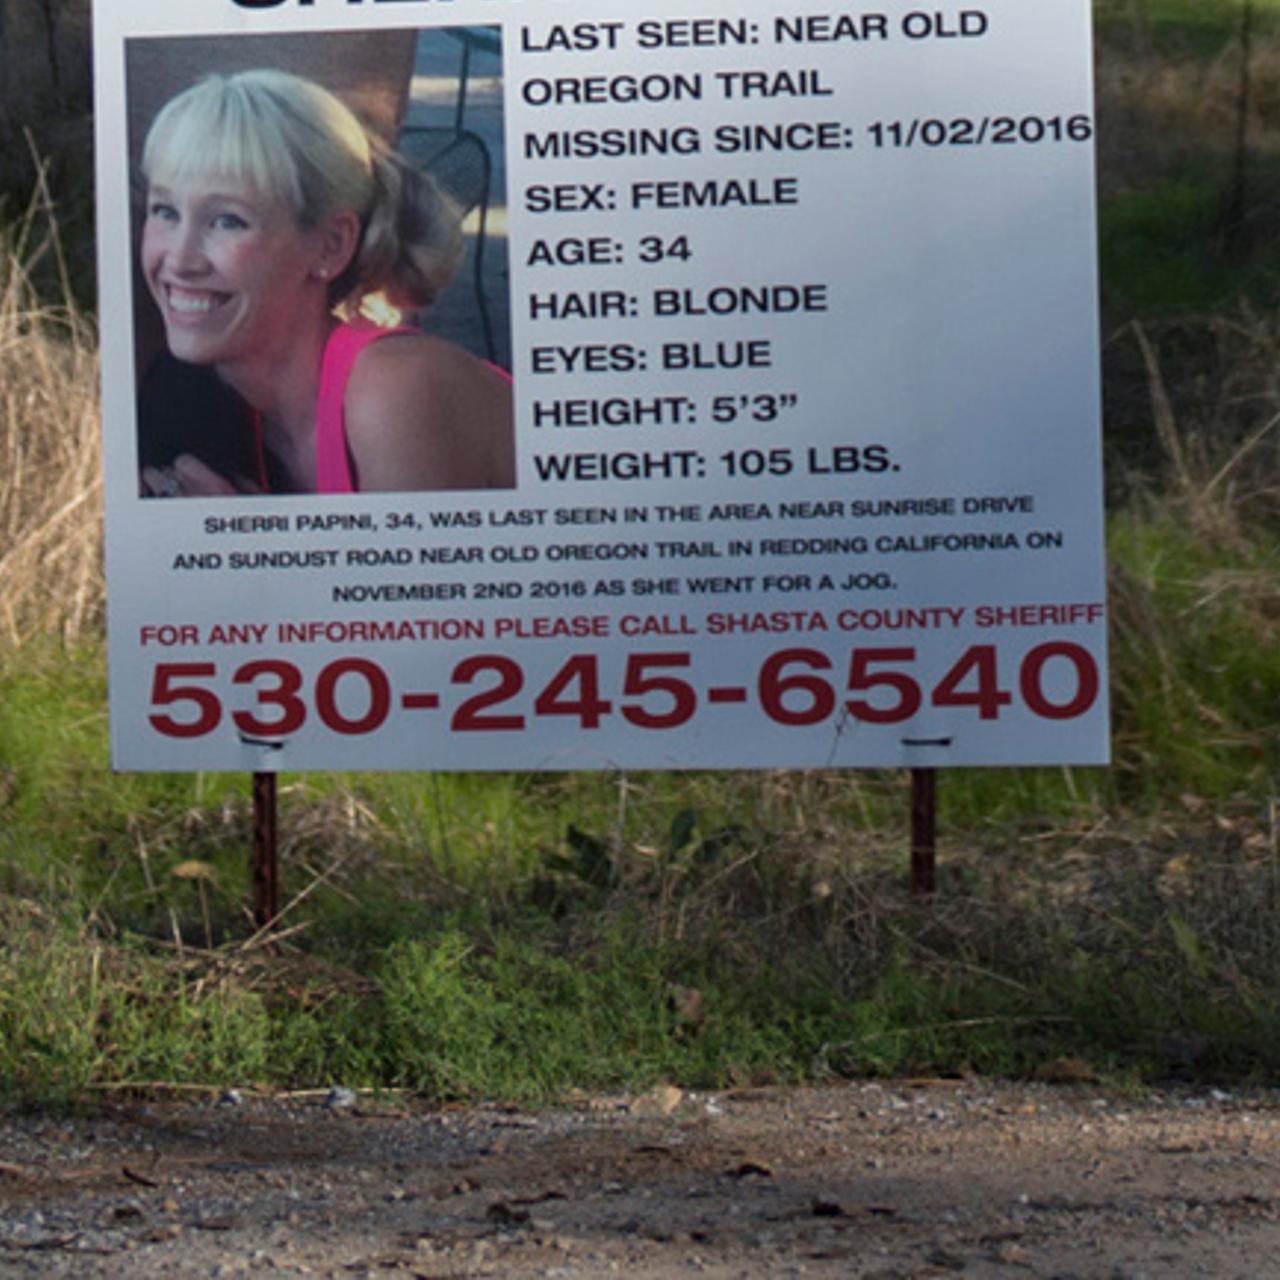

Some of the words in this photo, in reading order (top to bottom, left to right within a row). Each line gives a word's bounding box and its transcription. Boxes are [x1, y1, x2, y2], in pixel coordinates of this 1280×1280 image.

[522, 23, 623, 52] LAST
[638, 19, 758, 48] SEEN:
[775, 14, 888, 42] NEAR
[902, 11, 988, 39] OLD
[522, 75, 701, 105] OREGON
[716, 70, 833, 98] TRAIL
[525, 128, 700, 158] MISSING
[715, 123, 852, 152] SINCE:
[868, 115, 1092, 146] 11/02/2016
[526, 185, 615, 212] SEX:
[632, 178, 798, 208] FEMALE
[527, 238, 622, 265] AGE:
[640, 236, 692, 263] 34
[530, 291, 637, 319] HAIR:
[654, 285, 827, 315] BLONDE
[532, 344, 646, 373] EYES:
[663, 341, 771, 369] BLUE
[534, 397, 696, 427] HEIGHT:
[534, 451, 705, 480] WEIGHT:
[721, 449, 793, 476] 105
[808, 445, 900, 474] LBS.
[204, 516, 289, 534] SHERRI
[296, 515, 377, 531] PAPINI,
[386, 513, 422, 530] 34,
[430, 511, 482, 527] WAS
[489, 509, 547, 526] LAST
[554, 508, 617, 525] SEEN
[624, 507, 648, 522] IN
[655, 506, 701, 522] THE
[709, 504, 772, 520] AREA
[779, 501, 844, 518] NEAR
[851, 498, 955, 517] SUNRISE
[963, 496, 1032, 514] DRIVE
[173, 553, 222, 569] AND
[229, 550, 339, 569] SUNDUST
[347, 548, 413, 566] ROAD
[420, 547, 484, 563] NEAR
[490, 545, 539, 563] OLD
[546, 543, 648, 561] OREGON
[656, 542, 722, 557] TRAIL
[728, 541, 752, 556] IN
[760, 537, 868, 555] REDDING
[875, 534, 1020, 553] CALIFORNIA
[1026, 532, 1062, 549] ON
[333, 583, 466, 602] NOVEMBER
[474, 582, 523, 599] 2ND
[530, 580, 587, 598] 2016
[594, 580, 626, 596] AS
[632, 578, 679, 595] SHE
[687, 577, 755, 593] WENT
[763, 575, 811, 592] FOR
[818, 575, 834, 590] A
[841, 572, 897, 590] JOG.
[140, 625, 199, 646] FOR
[208, 624, 268, 644] ANY
[278, 619, 485, 642] INFORMATION
[495, 616, 609, 638] PLEASE
[619, 615, 697, 636] CALL
[707, 611, 828, 634] SHASTA
[837, 608, 965, 631] COUNTY
[975, 604, 1103, 627] SHERIFF
[147, 641, 1099, 738] 530-245-6540
